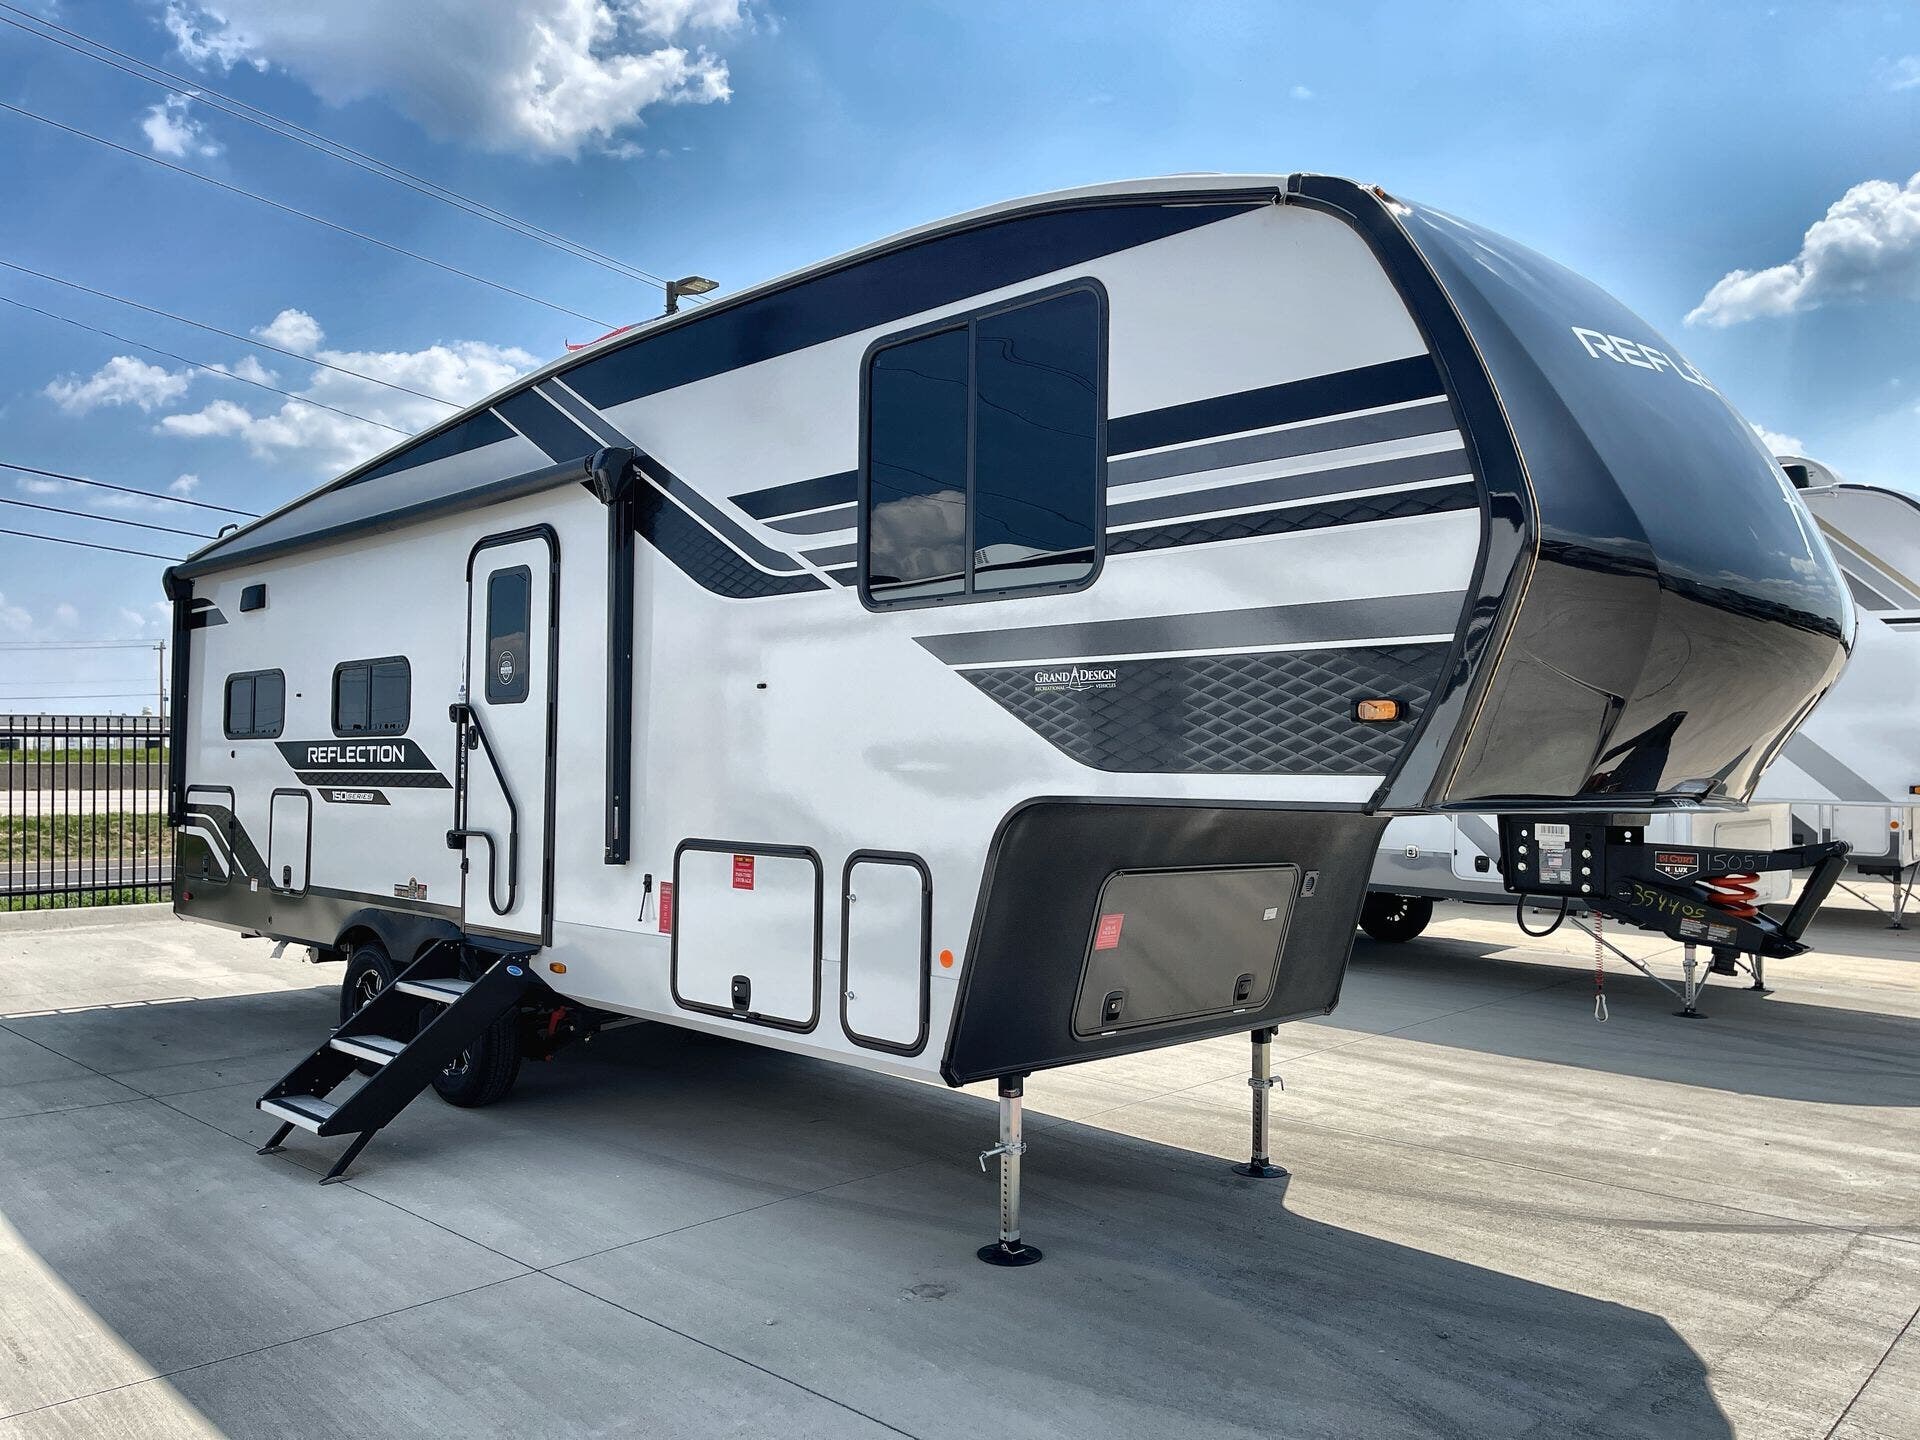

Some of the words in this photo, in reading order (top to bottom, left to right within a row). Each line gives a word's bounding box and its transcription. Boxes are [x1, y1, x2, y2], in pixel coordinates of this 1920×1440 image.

[1034, 670, 1070, 683] GRAND
[1080, 668, 1118, 682] DESIGN
[307, 744, 405, 763] REFLECTION
[332, 790, 347, 801] 150
[346, 792, 374, 802] SERIES
[1669, 854, 1695, 864] CURT
[1707, 853, 1770, 872] 15057
